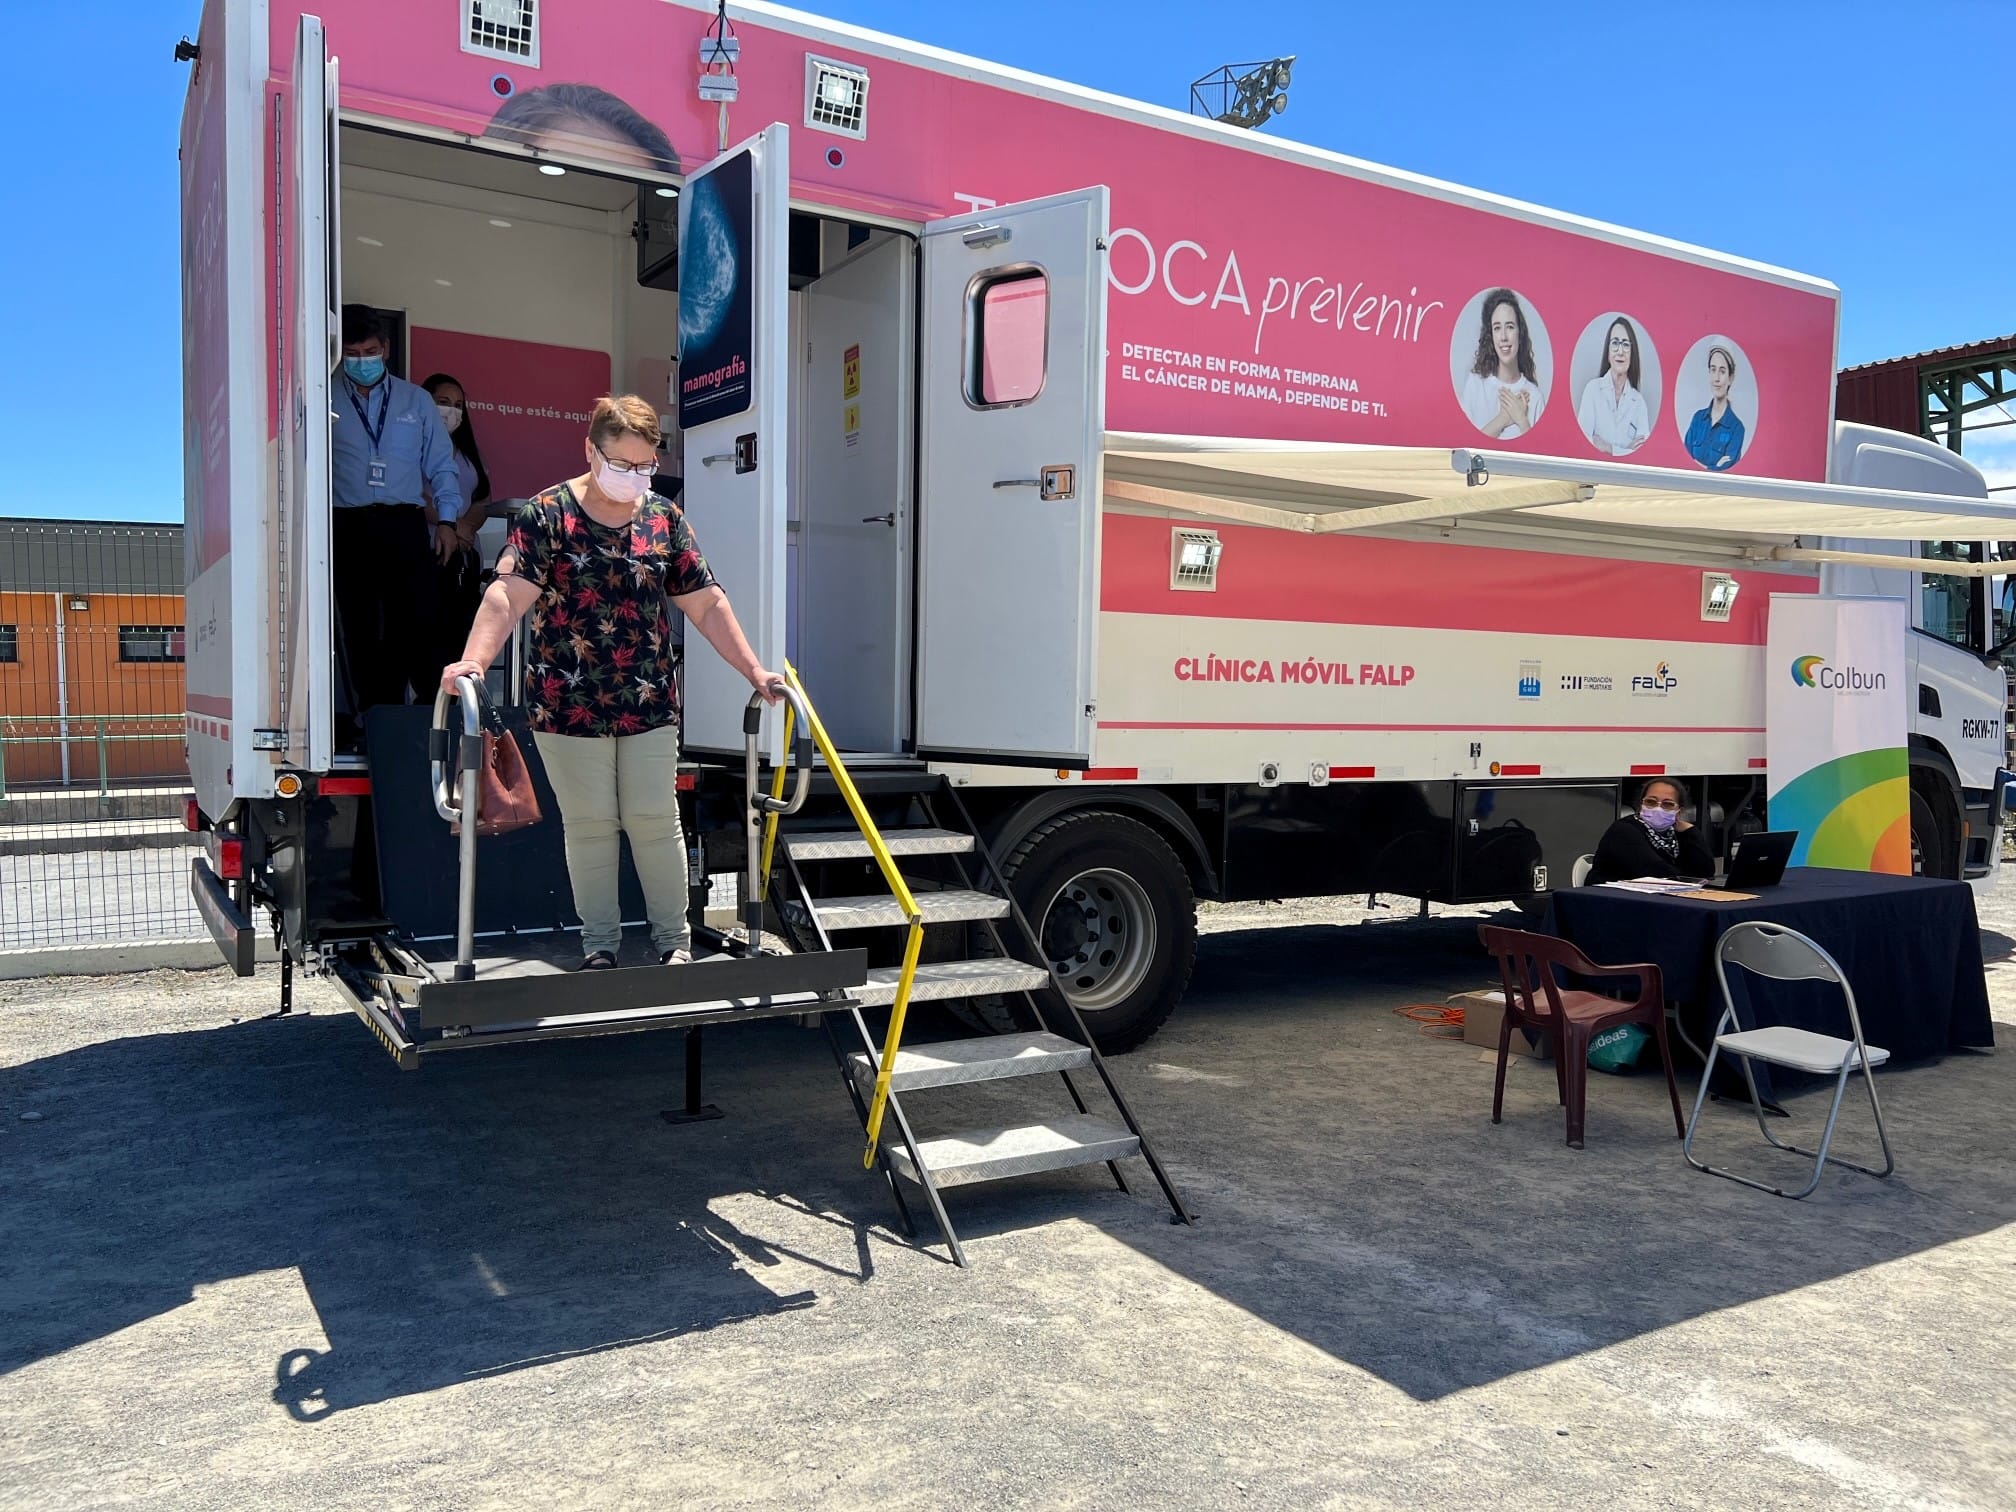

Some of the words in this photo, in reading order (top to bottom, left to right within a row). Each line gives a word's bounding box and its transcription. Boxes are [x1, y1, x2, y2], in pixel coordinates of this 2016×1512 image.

[1107, 227, 1250, 316] OCA
[1255, 276, 1444, 355] prevenir
[683, 355, 746, 393] mamografía
[1122, 342, 1202, 369] DETECTAR
[1206, 356, 1226, 373] EN
[1229, 359, 1281, 381] FORMA
[1284, 368, 1359, 393] TEMPRANA
[1121, 364, 1141, 382] EL
[1144, 366, 1207, 392] CÁNCER
[1211, 378, 1231, 395] DE
[1234, 381, 1282, 404] MAMA,
[1285, 389, 1348, 412] DEPENDE
[1351, 399, 1369, 415] DE
[1372, 402, 1388, 418] TI.
[498, 403, 523, 416] que
[526, 406, 561, 419] estés
[1174, 652, 1275, 684] CLÍNICA
[1281, 656, 1354, 685] MÓVIL
[1359, 664, 1415, 686] FALP
[1820, 666, 1886, 690] Colbun
